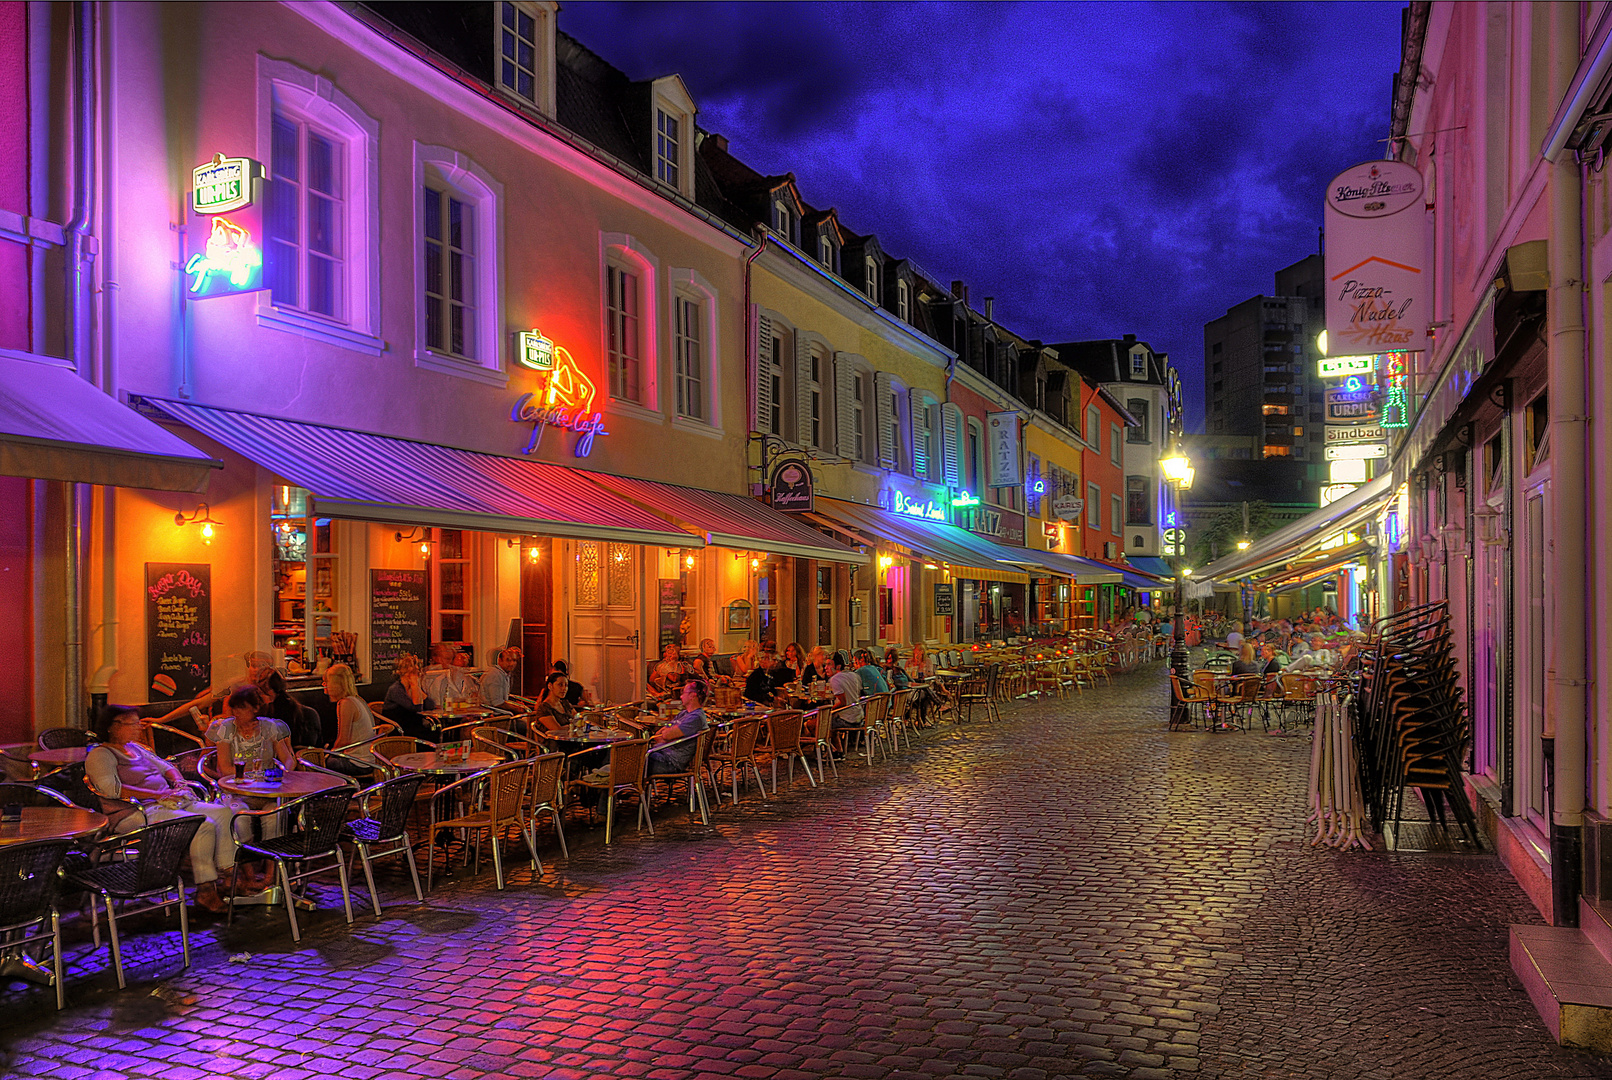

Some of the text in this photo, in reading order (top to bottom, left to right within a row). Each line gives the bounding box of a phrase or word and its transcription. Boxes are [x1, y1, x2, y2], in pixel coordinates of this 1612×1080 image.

[1338, 280, 1392, 301] Pizza-
[1350, 298, 1413, 323] Nudel
[1367, 323, 1415, 346] Haus
[1328, 427, 1383, 440] Sindbad
[998, 430, 1011, 472] RATZ
[974, 507, 1002, 537] RATZ
[176, 570, 206, 598] Day
